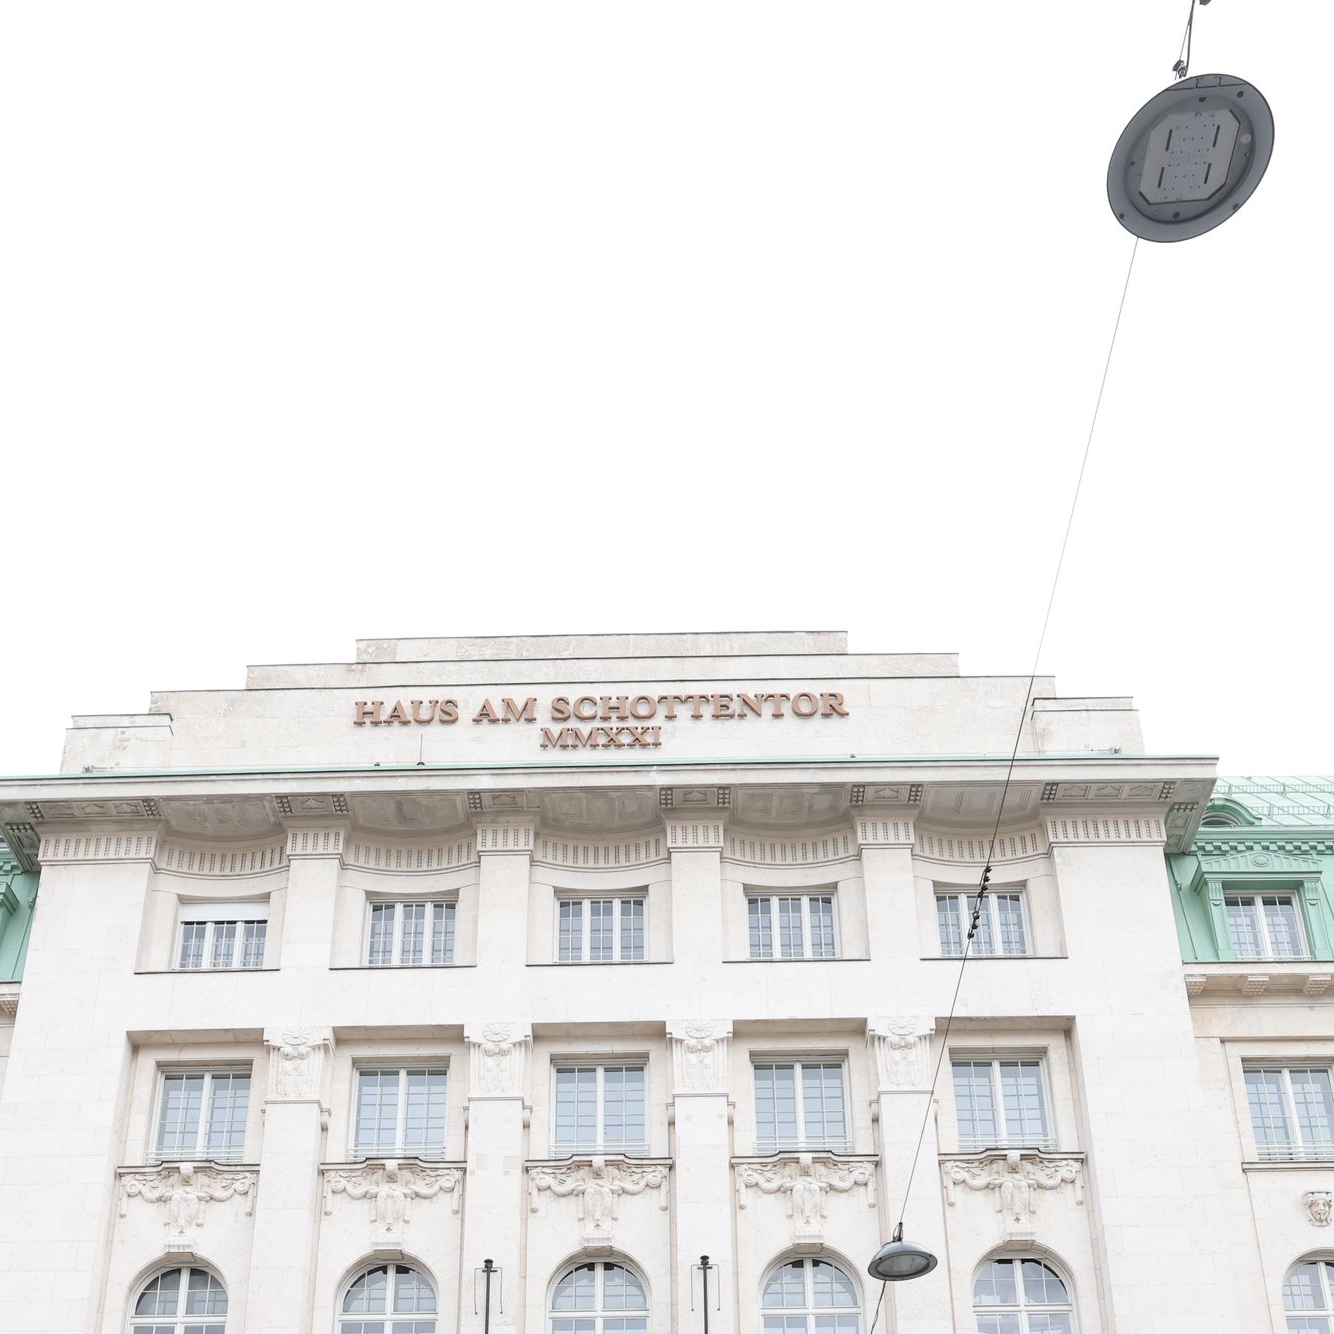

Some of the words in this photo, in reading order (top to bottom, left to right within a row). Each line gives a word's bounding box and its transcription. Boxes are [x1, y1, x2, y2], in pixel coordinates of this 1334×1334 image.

[353, 699, 459, 726] HAUS
[472, 697, 536, 722] AM
[551, 691, 850, 722] SCHOTTENTOR
[540, 725, 663, 749] MMXXI
